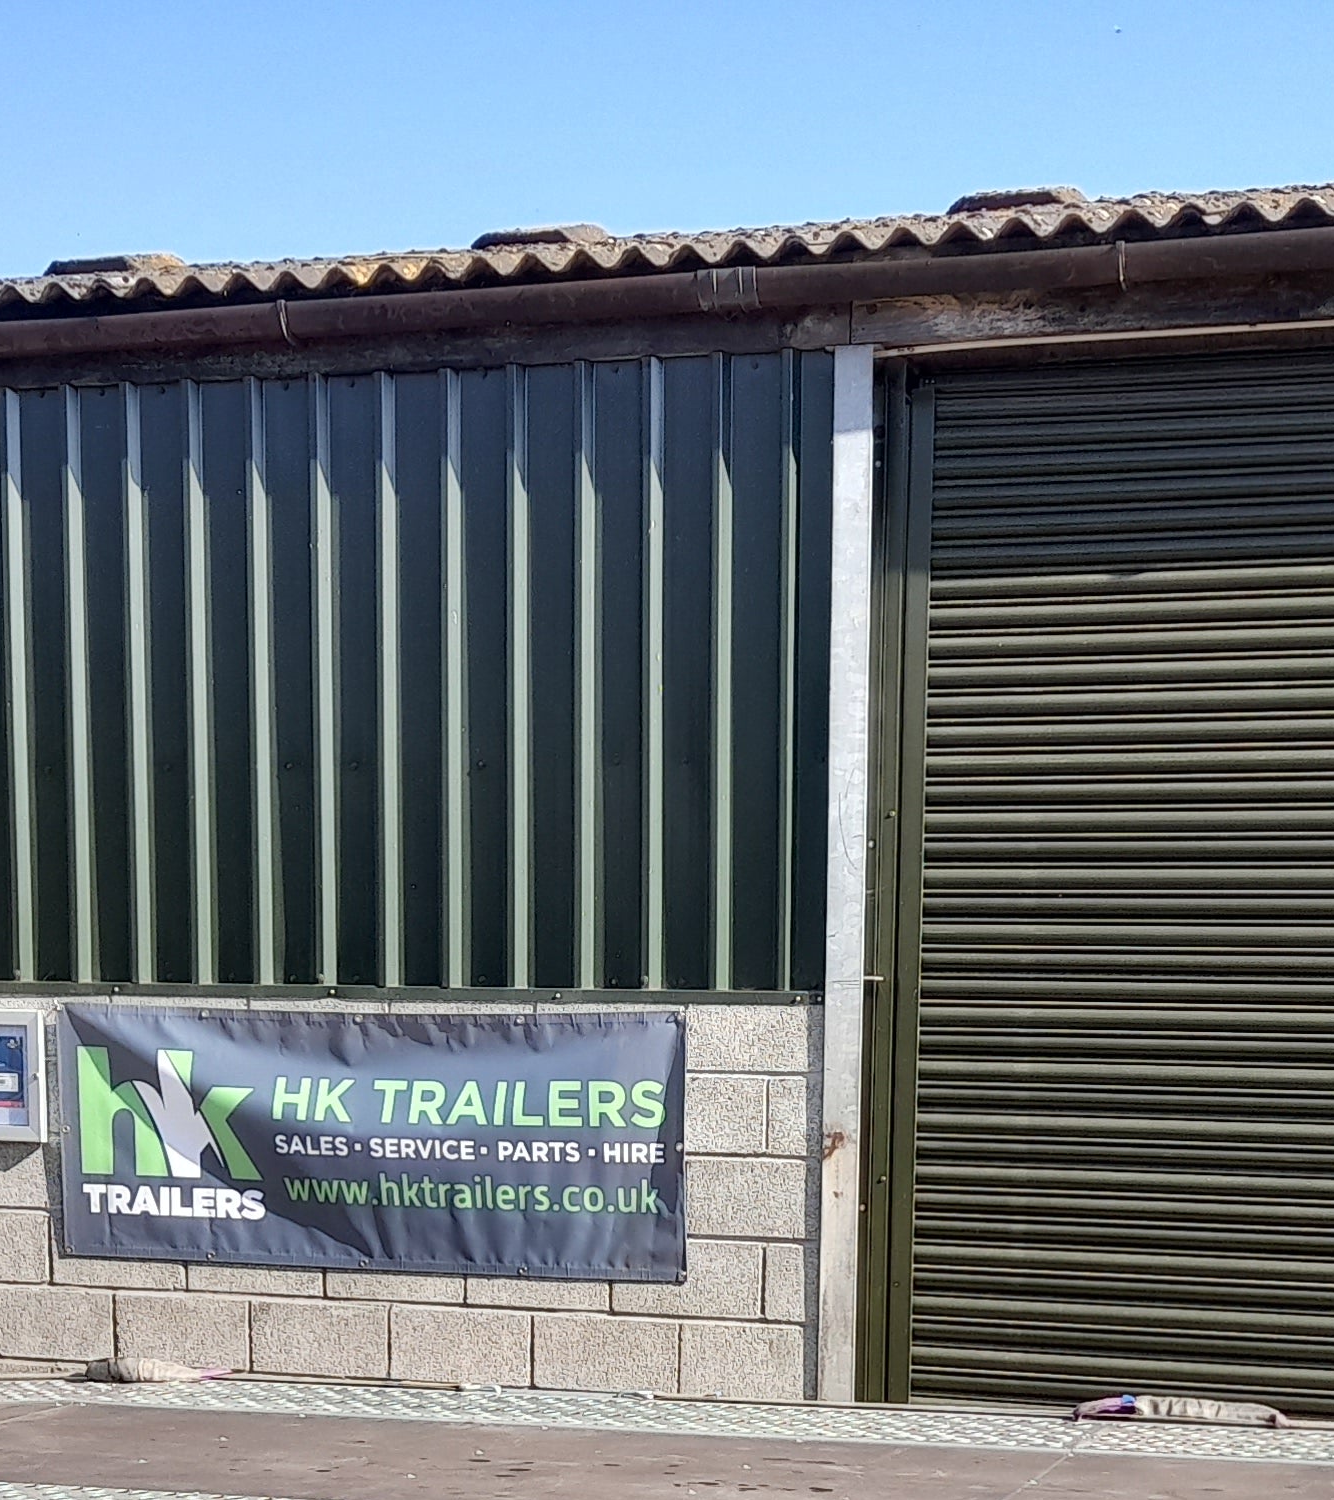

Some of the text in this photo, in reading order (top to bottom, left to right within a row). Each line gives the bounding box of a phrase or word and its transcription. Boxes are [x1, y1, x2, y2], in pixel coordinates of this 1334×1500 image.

[271, 1076, 666, 1128] HK TRAILERS
[274, 1135, 665, 1164] SALES SERVICE PARTS HIRE
[82, 1183, 266, 1220] TRAILERS
[283, 1171, 659, 1215] www.hktrailers.co.uk
